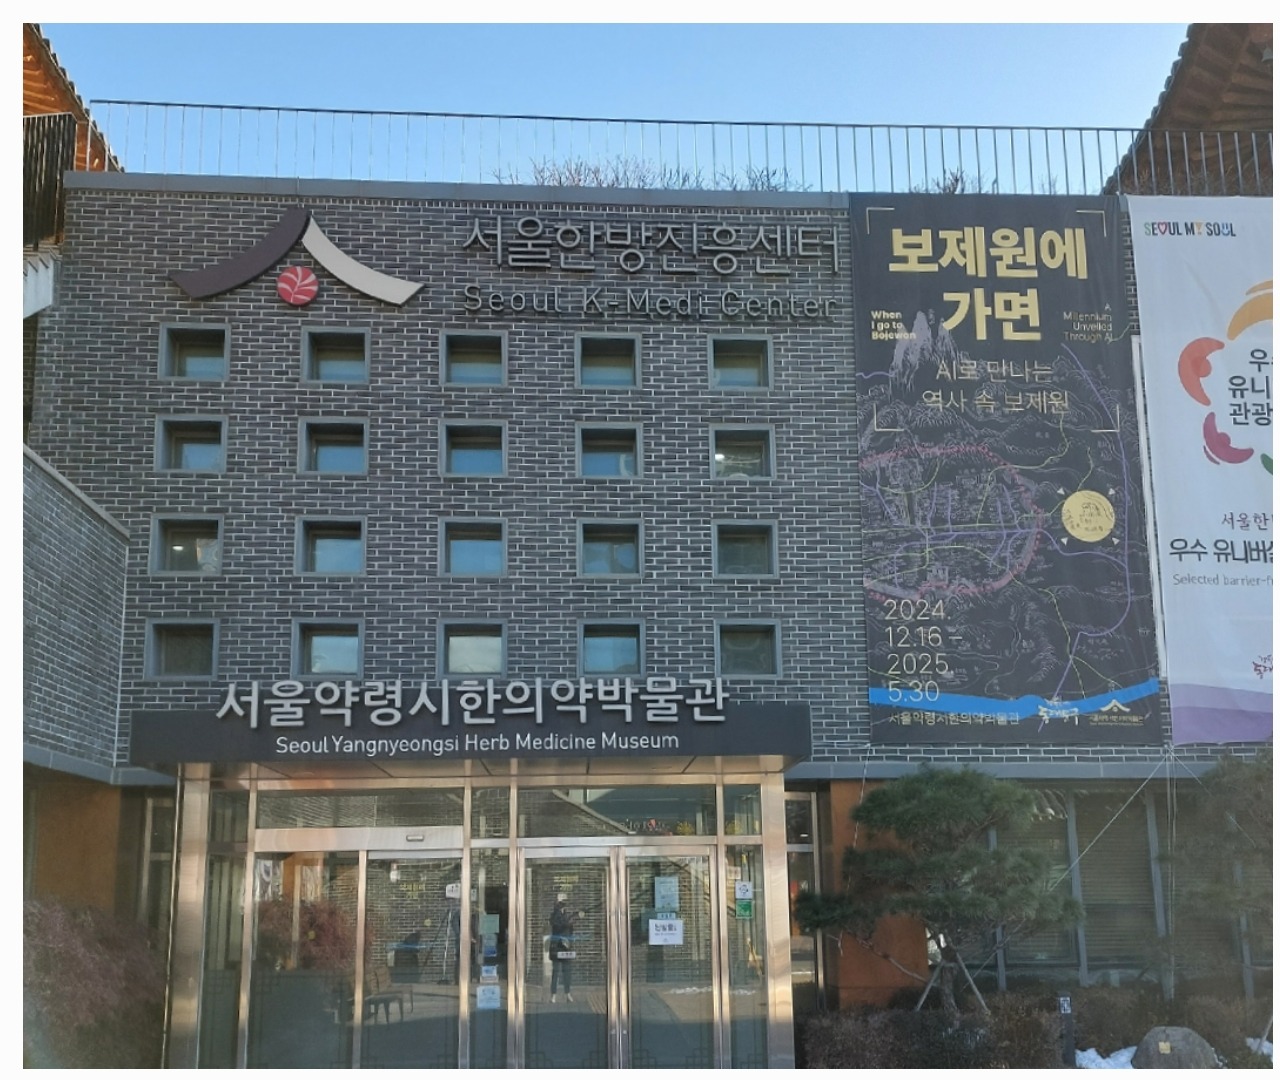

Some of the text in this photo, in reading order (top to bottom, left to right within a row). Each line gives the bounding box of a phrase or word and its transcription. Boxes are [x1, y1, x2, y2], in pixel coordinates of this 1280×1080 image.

[462, 214, 839, 275] 서울한방진흥센터
[889, 226, 1088, 279] 보제원에
[463, 283, 839, 323] Seoul K-Medi Center
[871, 310, 902, 319] When
[942, 287, 1041, 340] 가면
[877, 322, 890, 331] go
[892, 321, 903, 329] to
[1064, 332, 1102, 343] Through
[936, 359, 1053, 382] AI로 만나는
[922, 389, 968, 412] 역사
[1004, 389, 1070, 414] 보제원
[1221, 511, 1273, 531] 서울한
[1169, 538, 1208, 562] 우수
[1172, 573, 1219, 585] Selected
[884, 599, 952, 620] 2024.
[884, 626, 942, 648] 12.16
[215, 676, 730, 729] 서울약령시한의약박물관
[888, 680, 940, 702] 5.30
[276, 732, 680, 757] Seoul Yangnyeongsi Herb Medicine Museum
